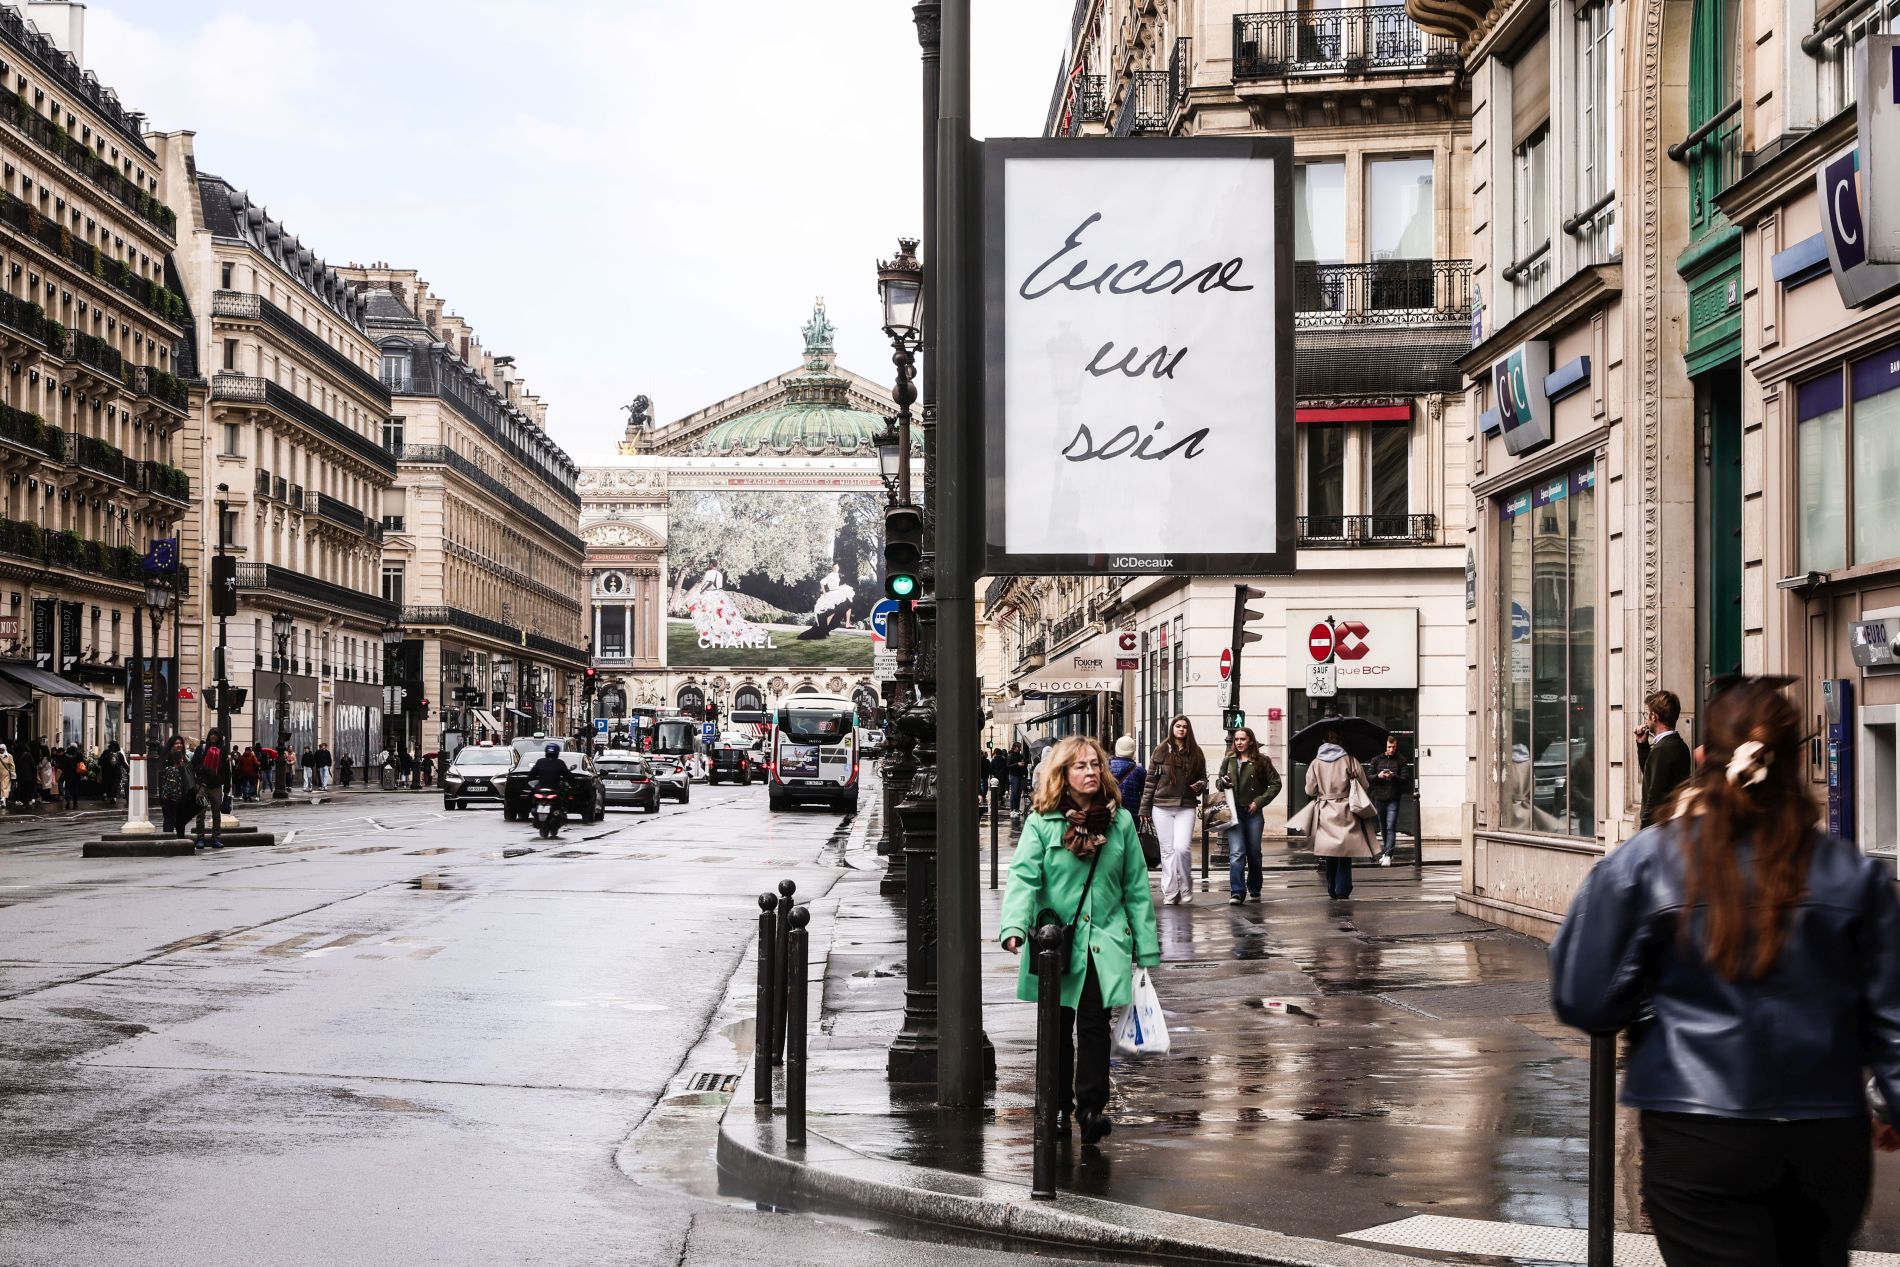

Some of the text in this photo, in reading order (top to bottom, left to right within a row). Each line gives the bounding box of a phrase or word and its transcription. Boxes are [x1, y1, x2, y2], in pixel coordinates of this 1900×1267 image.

[1018, 211, 1254, 301] Encore
[1499, 366, 1526, 418] CIC
[1112, 557, 1174, 569] JCDecaux
[1865, 624, 1887, 645] EURO
[697, 636, 778, 649] CHANEL
[1313, 666, 1329, 675] SAUF
[1362, 666, 1391, 675] BCP
[1029, 681, 1111, 691] CHOCOLAT
[597, 721, 605, 731] P
[705, 725, 712, 733] P
